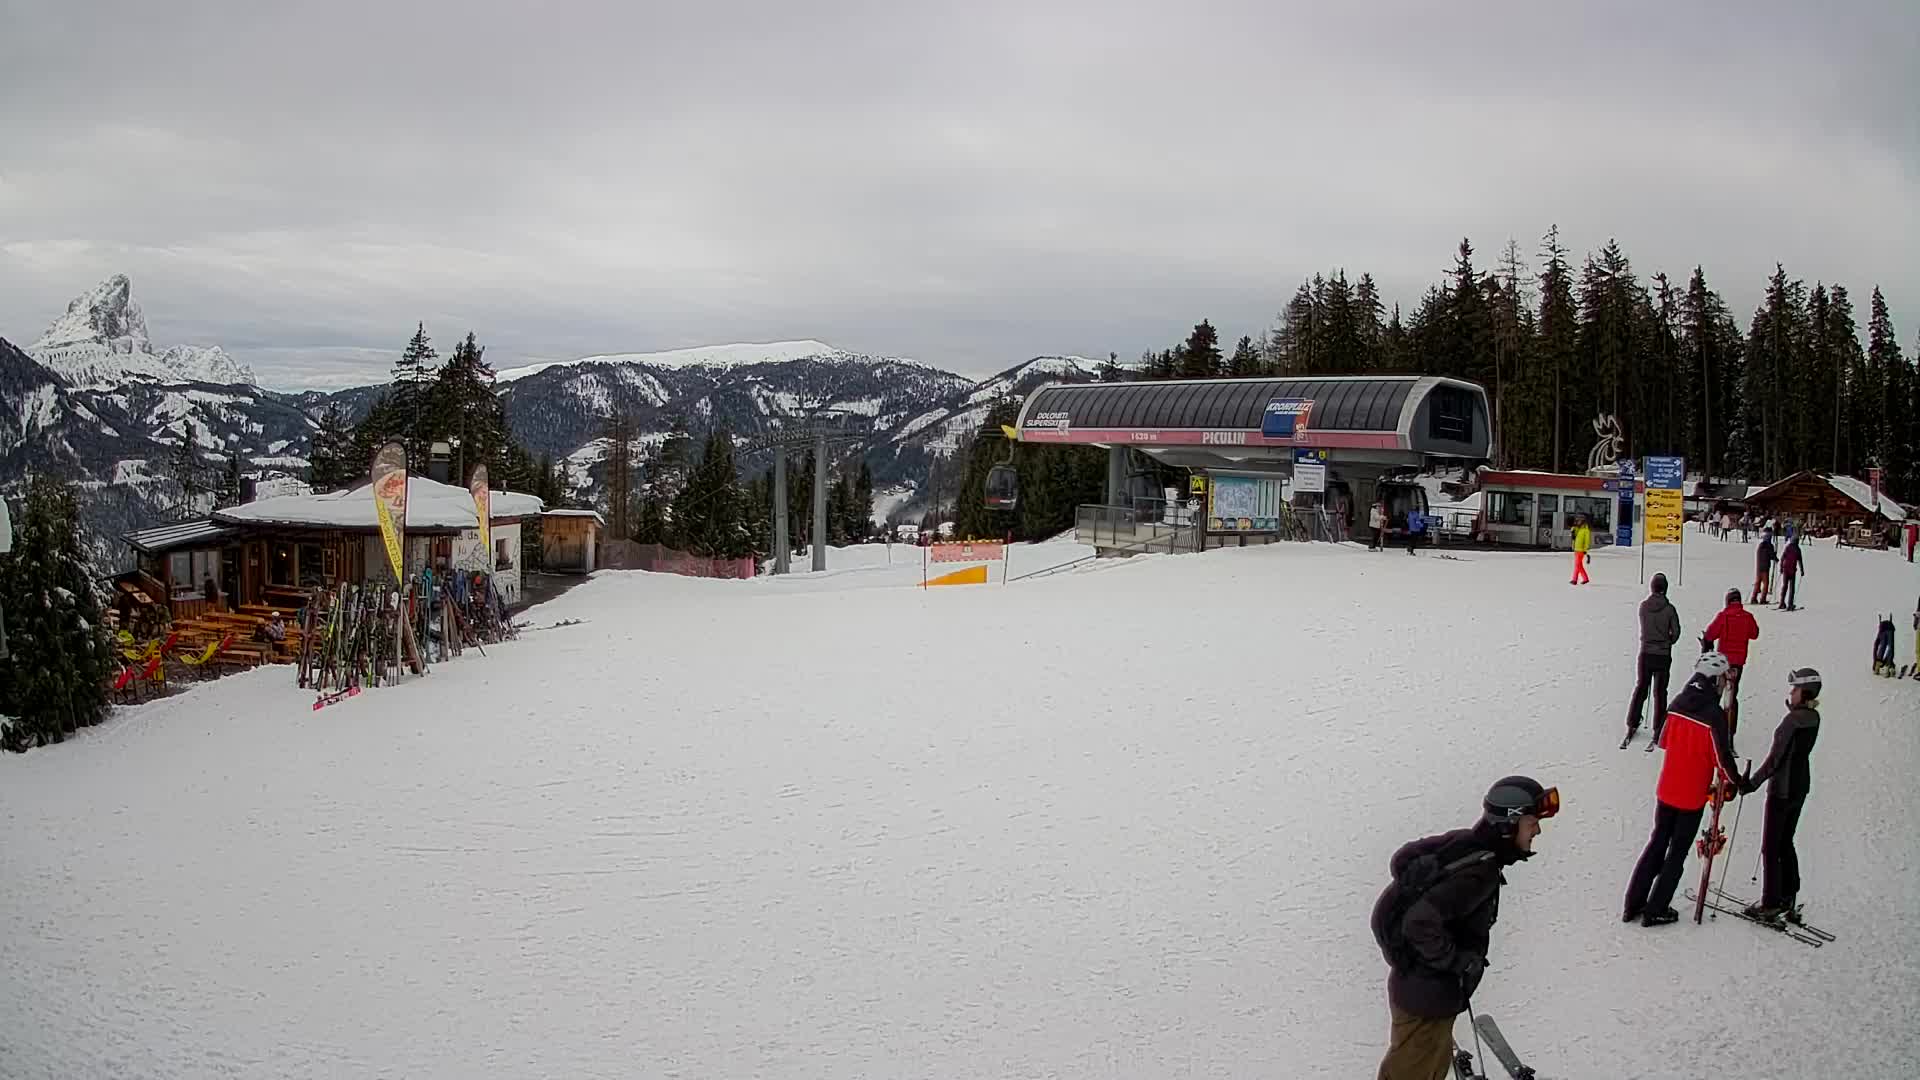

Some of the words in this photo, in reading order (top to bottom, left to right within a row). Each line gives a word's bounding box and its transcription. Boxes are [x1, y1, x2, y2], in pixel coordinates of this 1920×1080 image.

[1037, 412, 1068, 420] DOLOMITI
[1026, 419, 1058, 427] SUPERSKI
[1202, 432, 1245, 445] PICULIN
